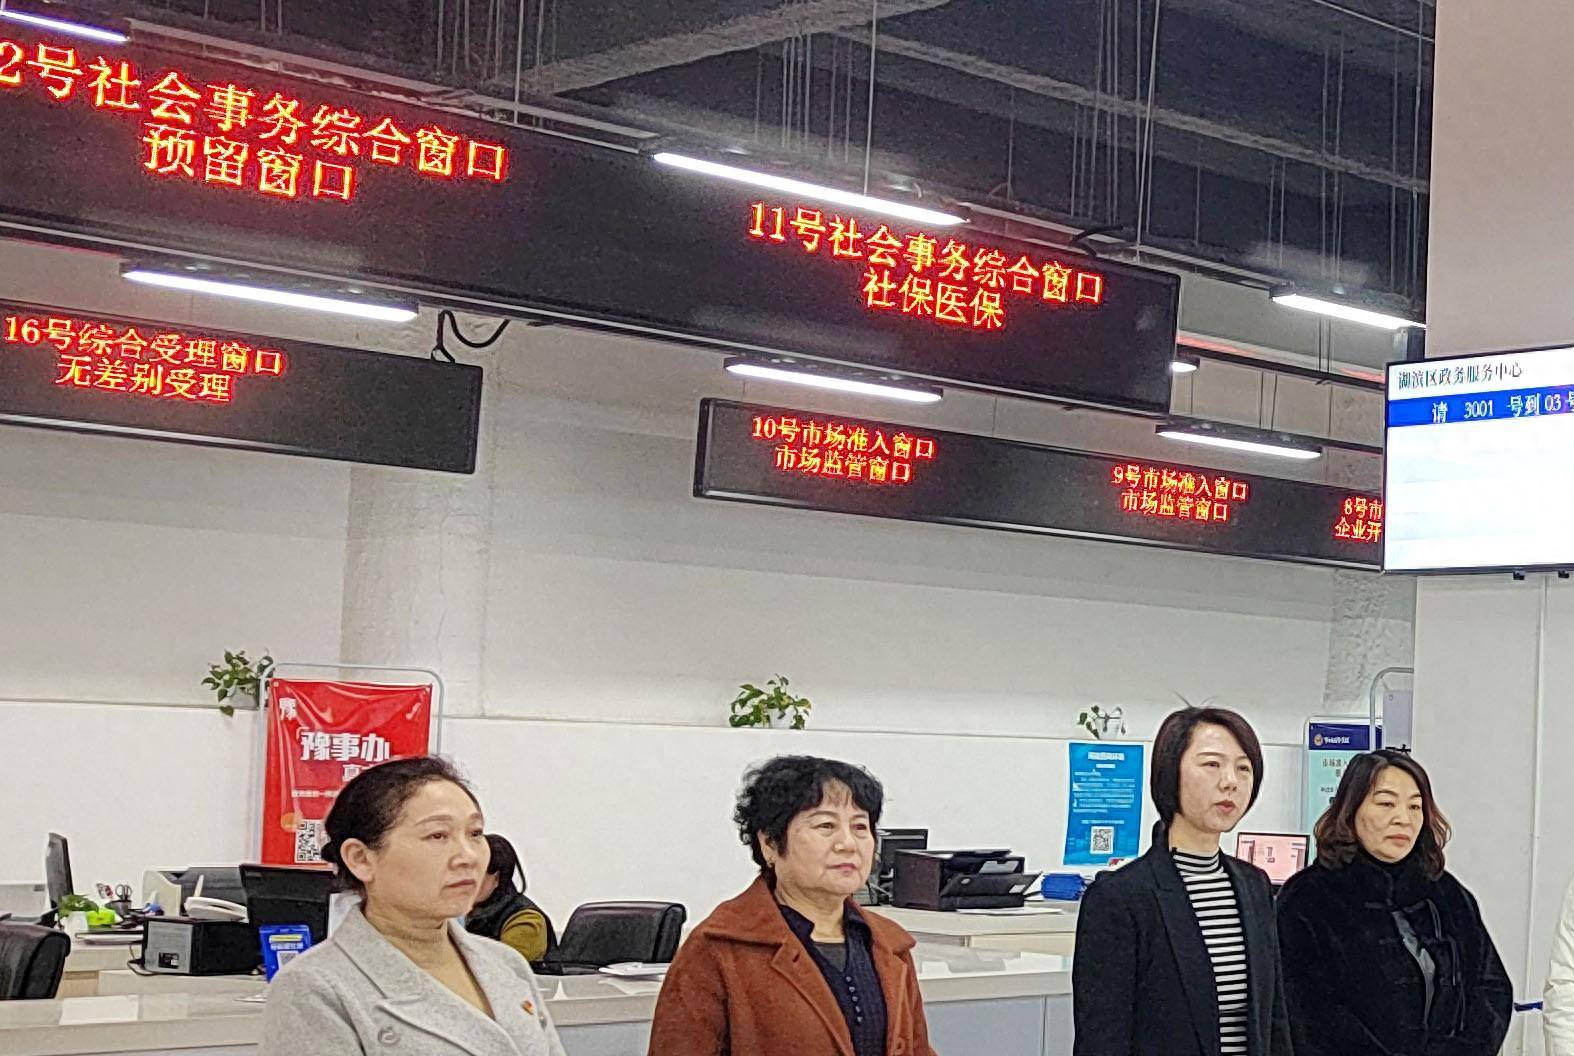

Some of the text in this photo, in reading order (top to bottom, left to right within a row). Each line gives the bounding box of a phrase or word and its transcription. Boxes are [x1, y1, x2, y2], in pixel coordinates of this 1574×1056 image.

[0, 41, 509, 179] 2号社会事务综合窗口
[142, 122, 354, 200] 预留窗口
[748, 202, 1103, 304] 11号社会事务综合窗口
[862, 270, 1005, 329] 社保医保
[4, 316, 283, 377] 16号综合受理窗口
[56, 353, 231, 403] 无差别受理
[1432, 402, 1449, 424] 请
[1464, 401, 1494, 419] 3001
[1507, 395, 1540, 416] 号到
[1545, 394, 1562, 412] 03
[752, 416, 934, 460] 10号市场准入窗口
[775, 446, 910, 483] 市场监管窗口
[1111, 465, 1248, 501] 9号市场准入窗口
[1121, 491, 1229, 522] 市场监管窗口
[1344, 496, 1383, 520] 8号市
[1334, 516, 1383, 543] 企业开
[342, 764, 372, 782] 真
